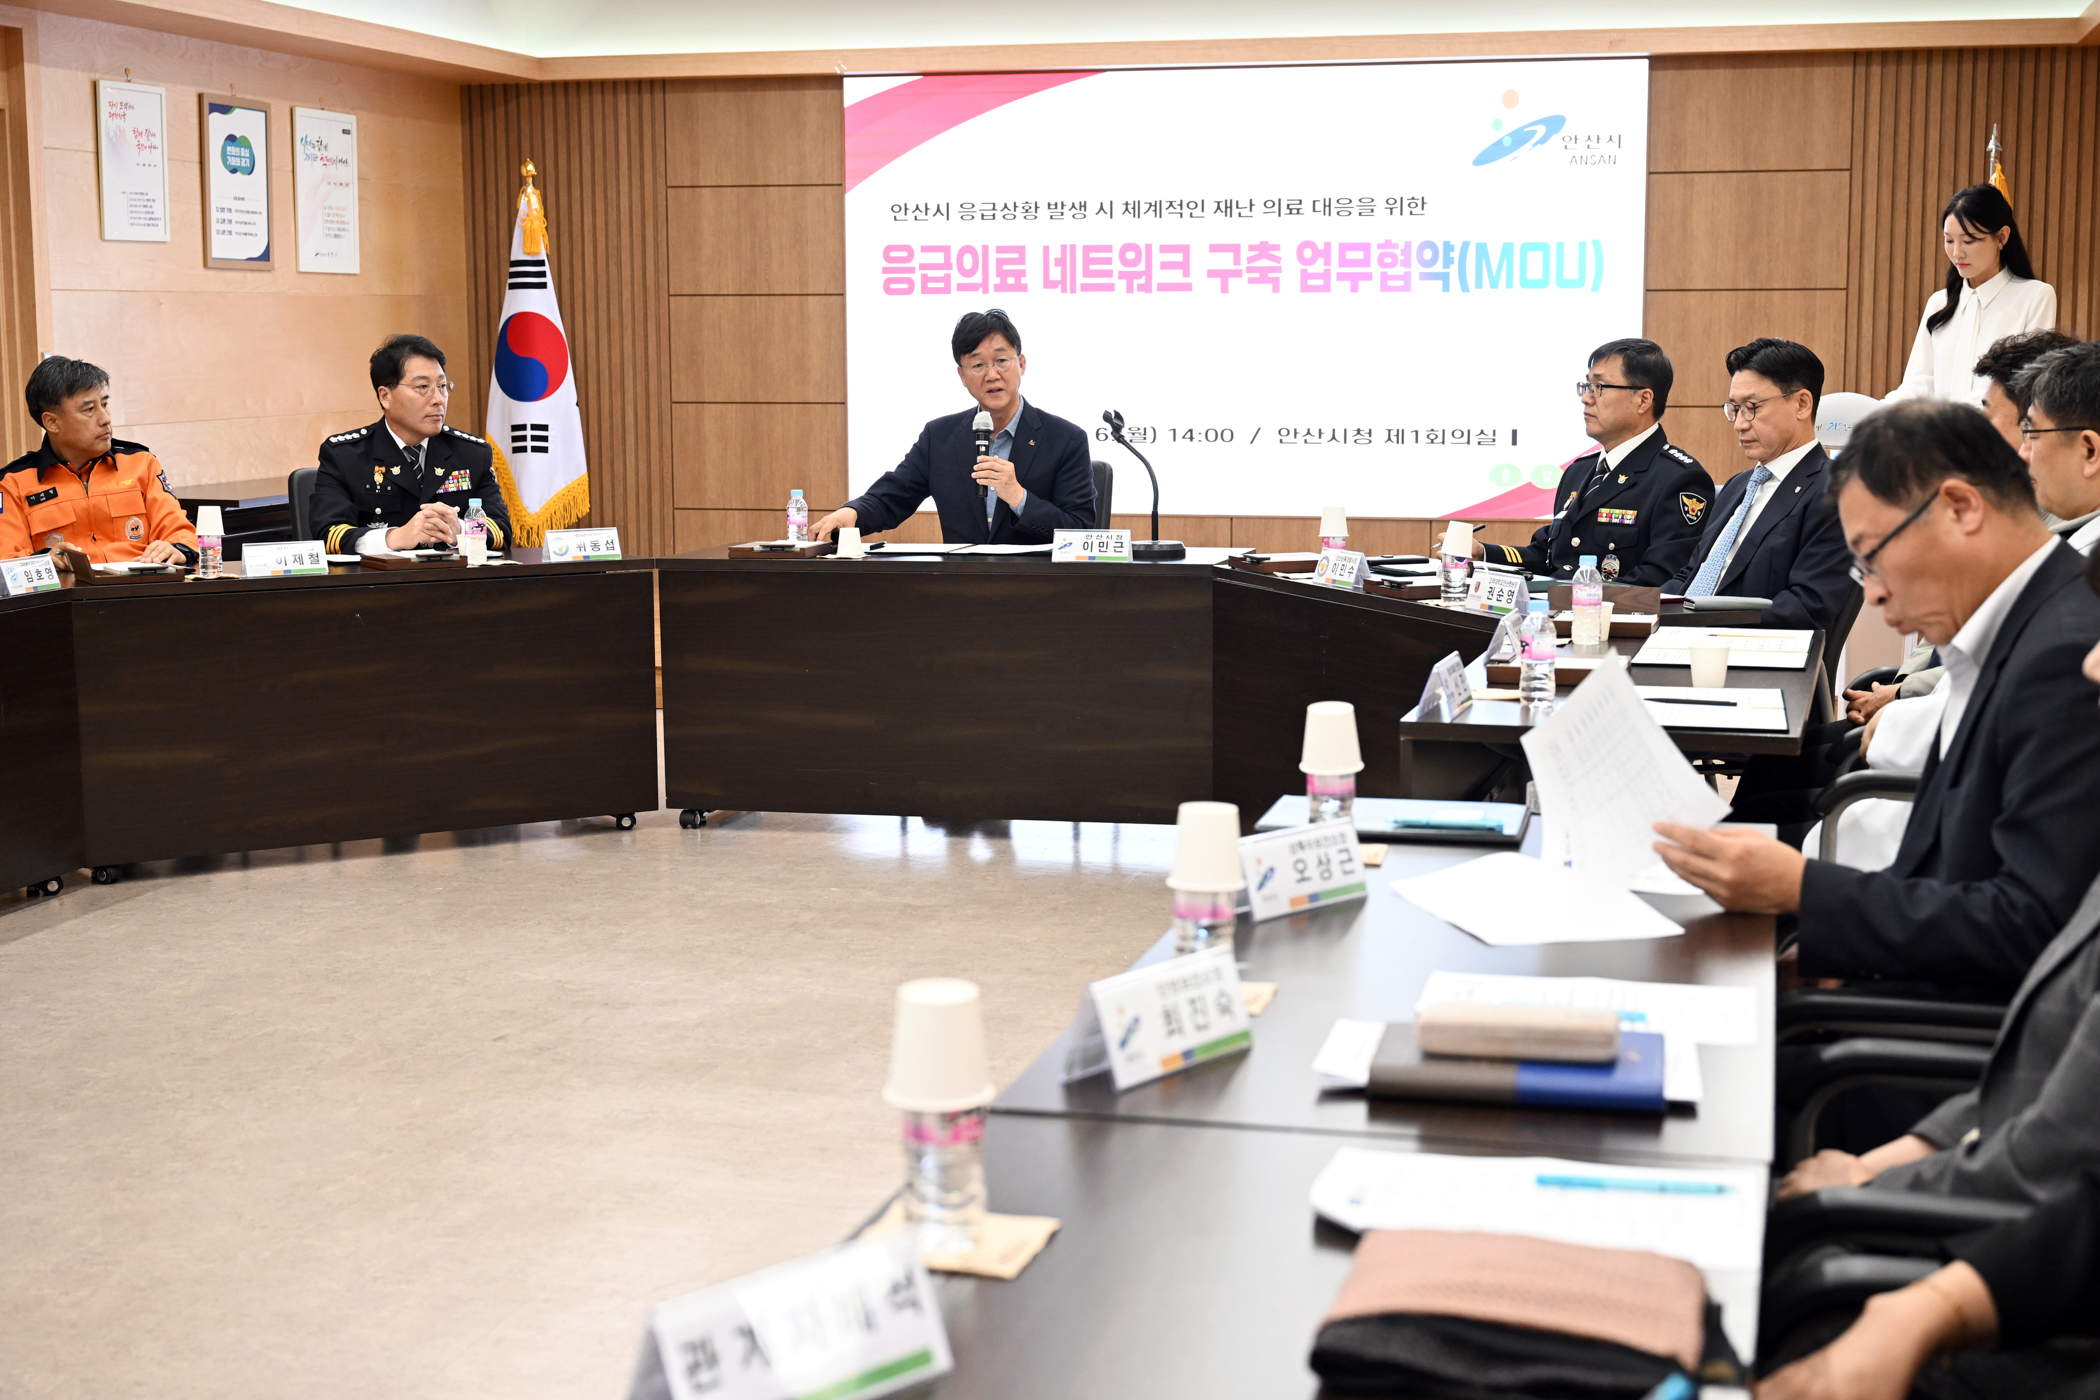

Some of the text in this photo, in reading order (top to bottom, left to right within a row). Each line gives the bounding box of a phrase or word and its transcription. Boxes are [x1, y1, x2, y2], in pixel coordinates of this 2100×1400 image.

[1561, 133, 1622, 151] 안산시
[1569, 154, 1618, 167] ANSAN
[890, 196, 1428, 222] 안산시 응급상황 발생 시 체계적인 재난 의료 대응을 위한
[881, 238, 1605, 296] 응급의료 네트워크 구축 업무협약(MOU)
[1095, 426, 1497, 446] 6.월) 14:00 / 안산시청 제1회의실
[575, 538, 616, 554] 위동섭
[1082, 540, 1125, 553] 이민근
[275, 552, 321, 567] 이제철
[23, 567, 55, 583] 임호영
[1331, 562, 1355, 578] 이민수
[1486, 586, 1516, 605] 권순영
[1292, 846, 1356, 884] 오상근
[1160, 988, 1238, 1038] 최진숙
